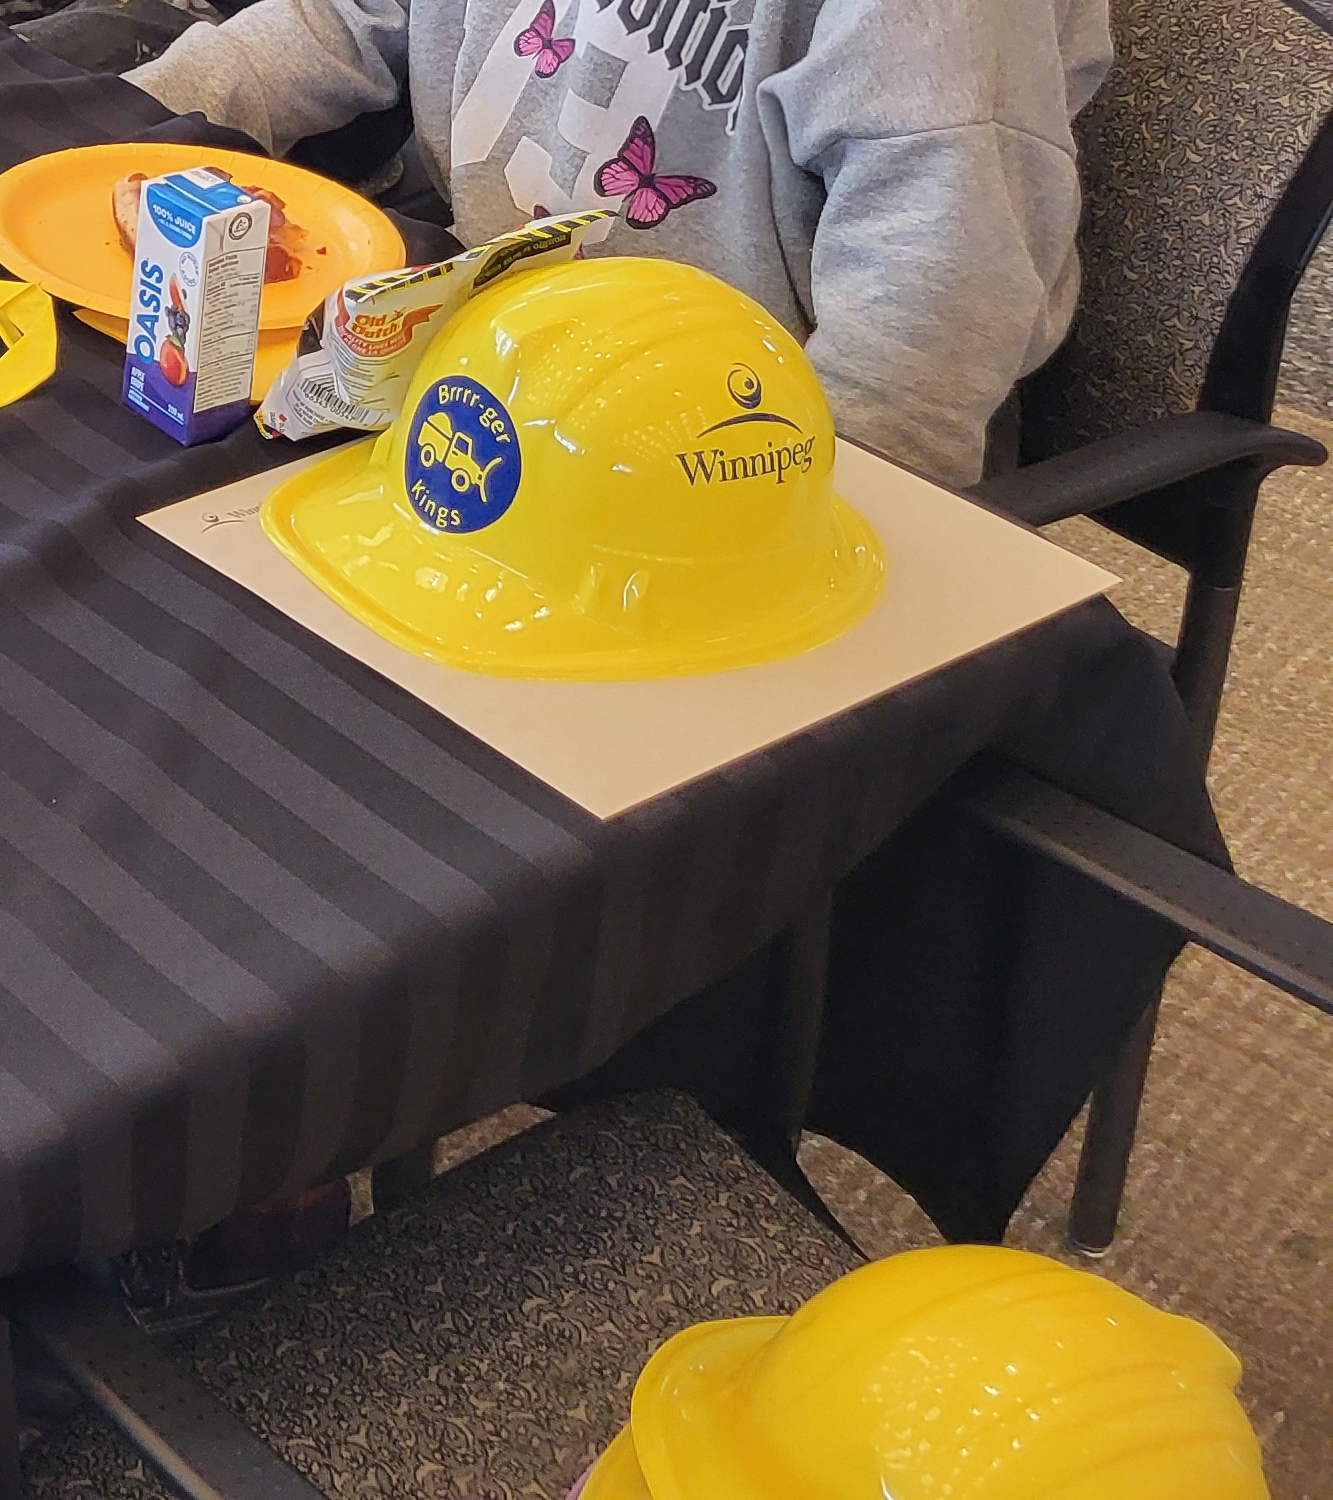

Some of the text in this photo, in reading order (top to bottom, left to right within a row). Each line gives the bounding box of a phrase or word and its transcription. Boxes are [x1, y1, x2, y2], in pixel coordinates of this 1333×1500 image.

[152, 203, 173, 222] 100%
[174, 215, 196, 236] JUICE
[134, 258, 164, 365] OASIS
[355, 314, 387, 327] Old
[351, 322, 398, 339] Dutch
[675, 436, 815, 486] Winnipeg
